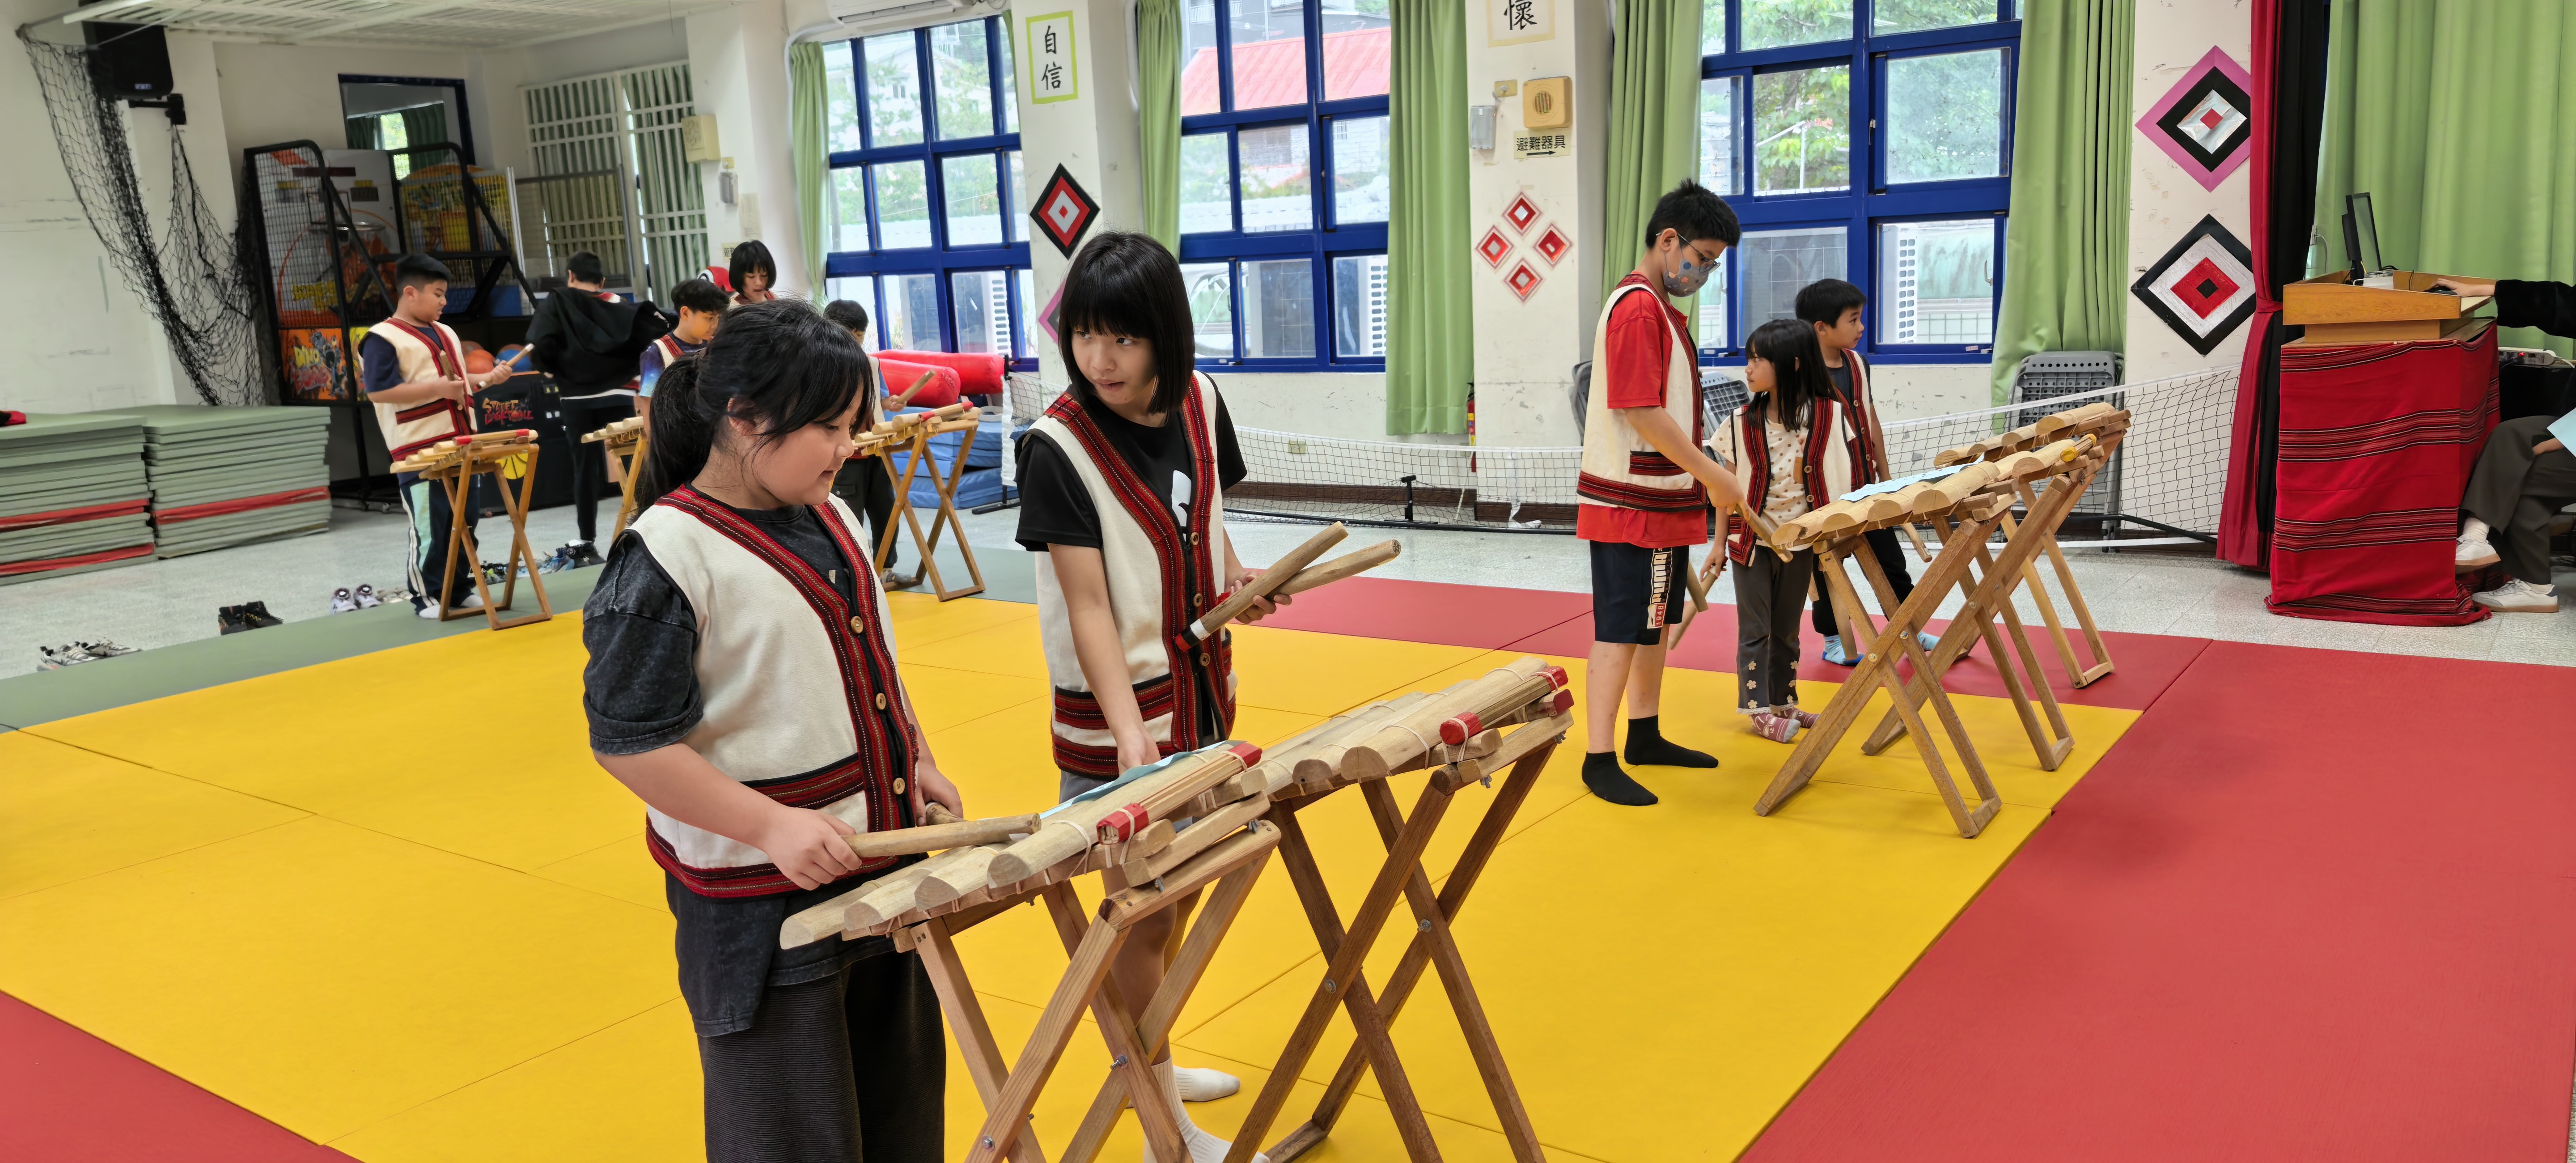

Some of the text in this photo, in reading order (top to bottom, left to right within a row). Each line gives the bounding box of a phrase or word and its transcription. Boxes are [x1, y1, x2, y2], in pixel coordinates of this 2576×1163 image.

[1041, 25, 1063, 90] 自信
[1517, 135, 1565, 151] 避難器具
[1652, 554, 1667, 603] PUMA
[1656, 605, 1664, 625] 1948
